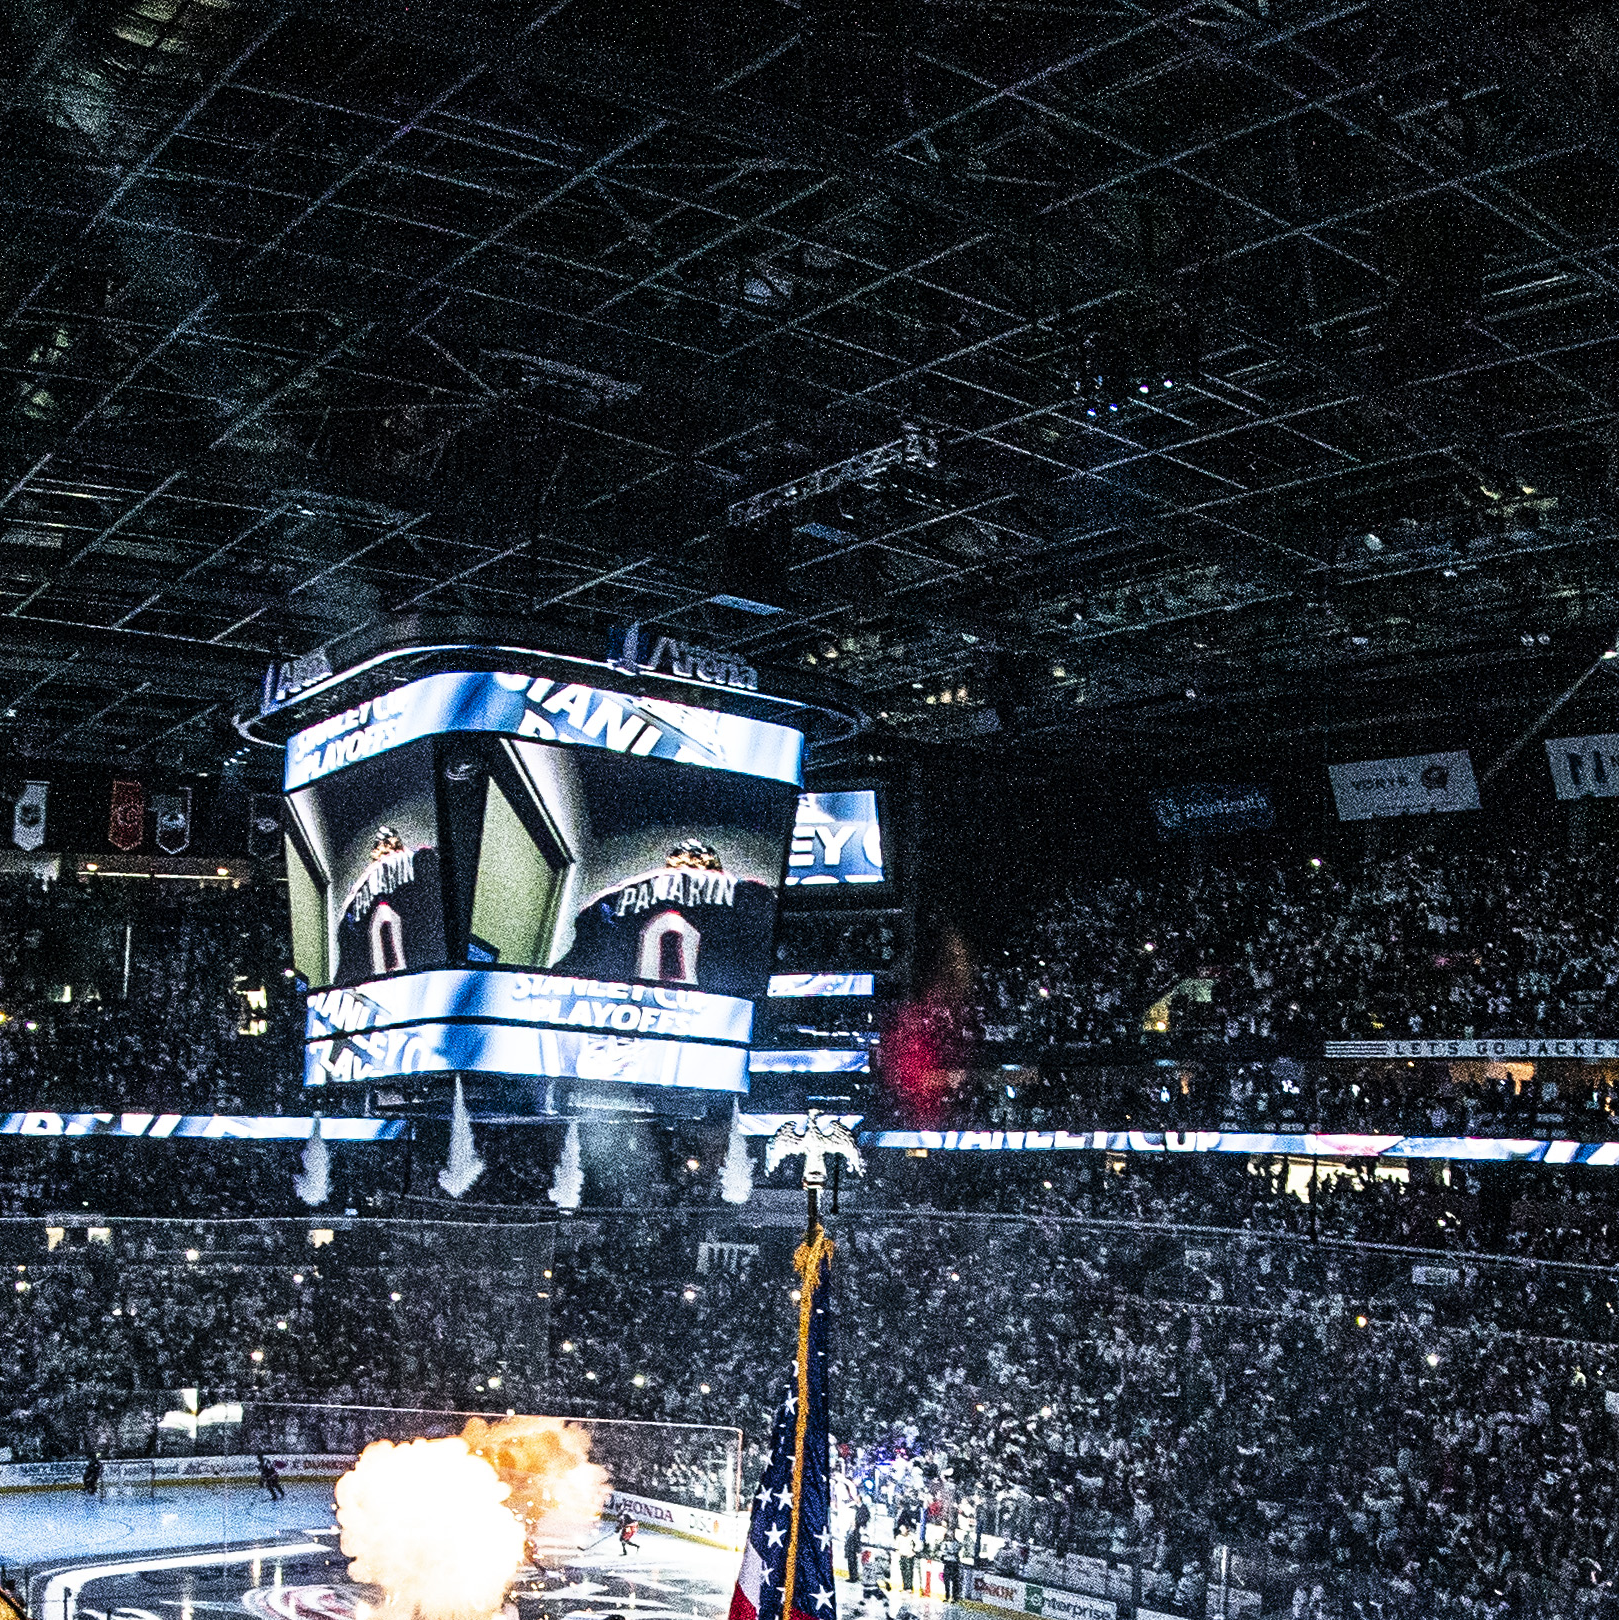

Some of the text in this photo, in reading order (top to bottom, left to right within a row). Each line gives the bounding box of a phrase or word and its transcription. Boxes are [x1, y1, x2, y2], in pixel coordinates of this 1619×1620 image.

[615, 871, 736, 917] PANARIN
[531, 999, 692, 1036] PLAYOFFS
[1477, 1042, 1506, 1057] GO
[621, 1497, 674, 1524] HONDA
